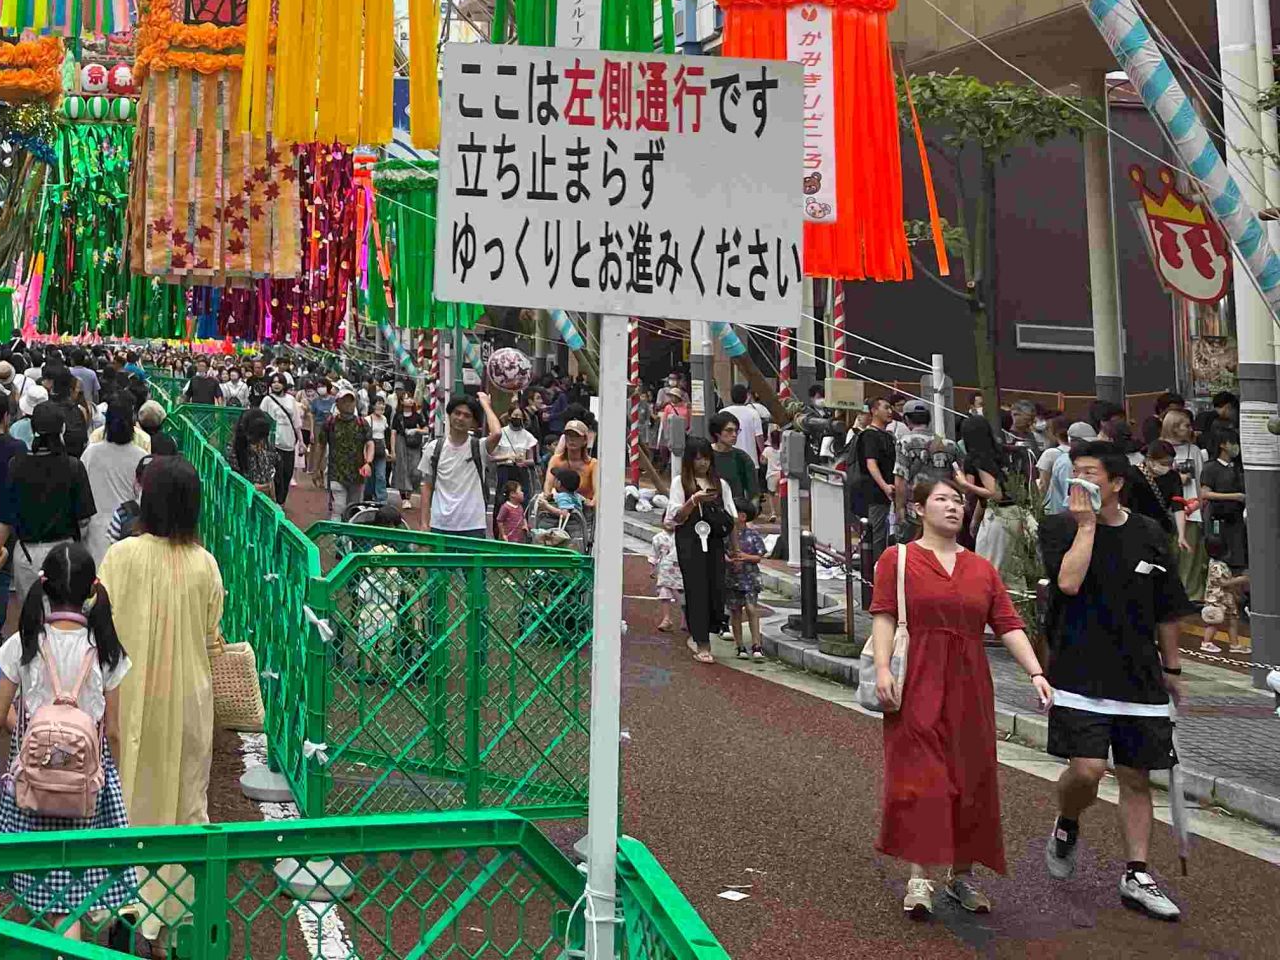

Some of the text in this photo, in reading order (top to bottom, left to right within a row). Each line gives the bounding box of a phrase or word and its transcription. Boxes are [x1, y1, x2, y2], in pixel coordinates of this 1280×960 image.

[458, 58, 779, 137] ここは左側通行です
[455, 132, 666, 210] 立ち止まらず
[452, 212, 803, 302] ゆっくりとお進みください
